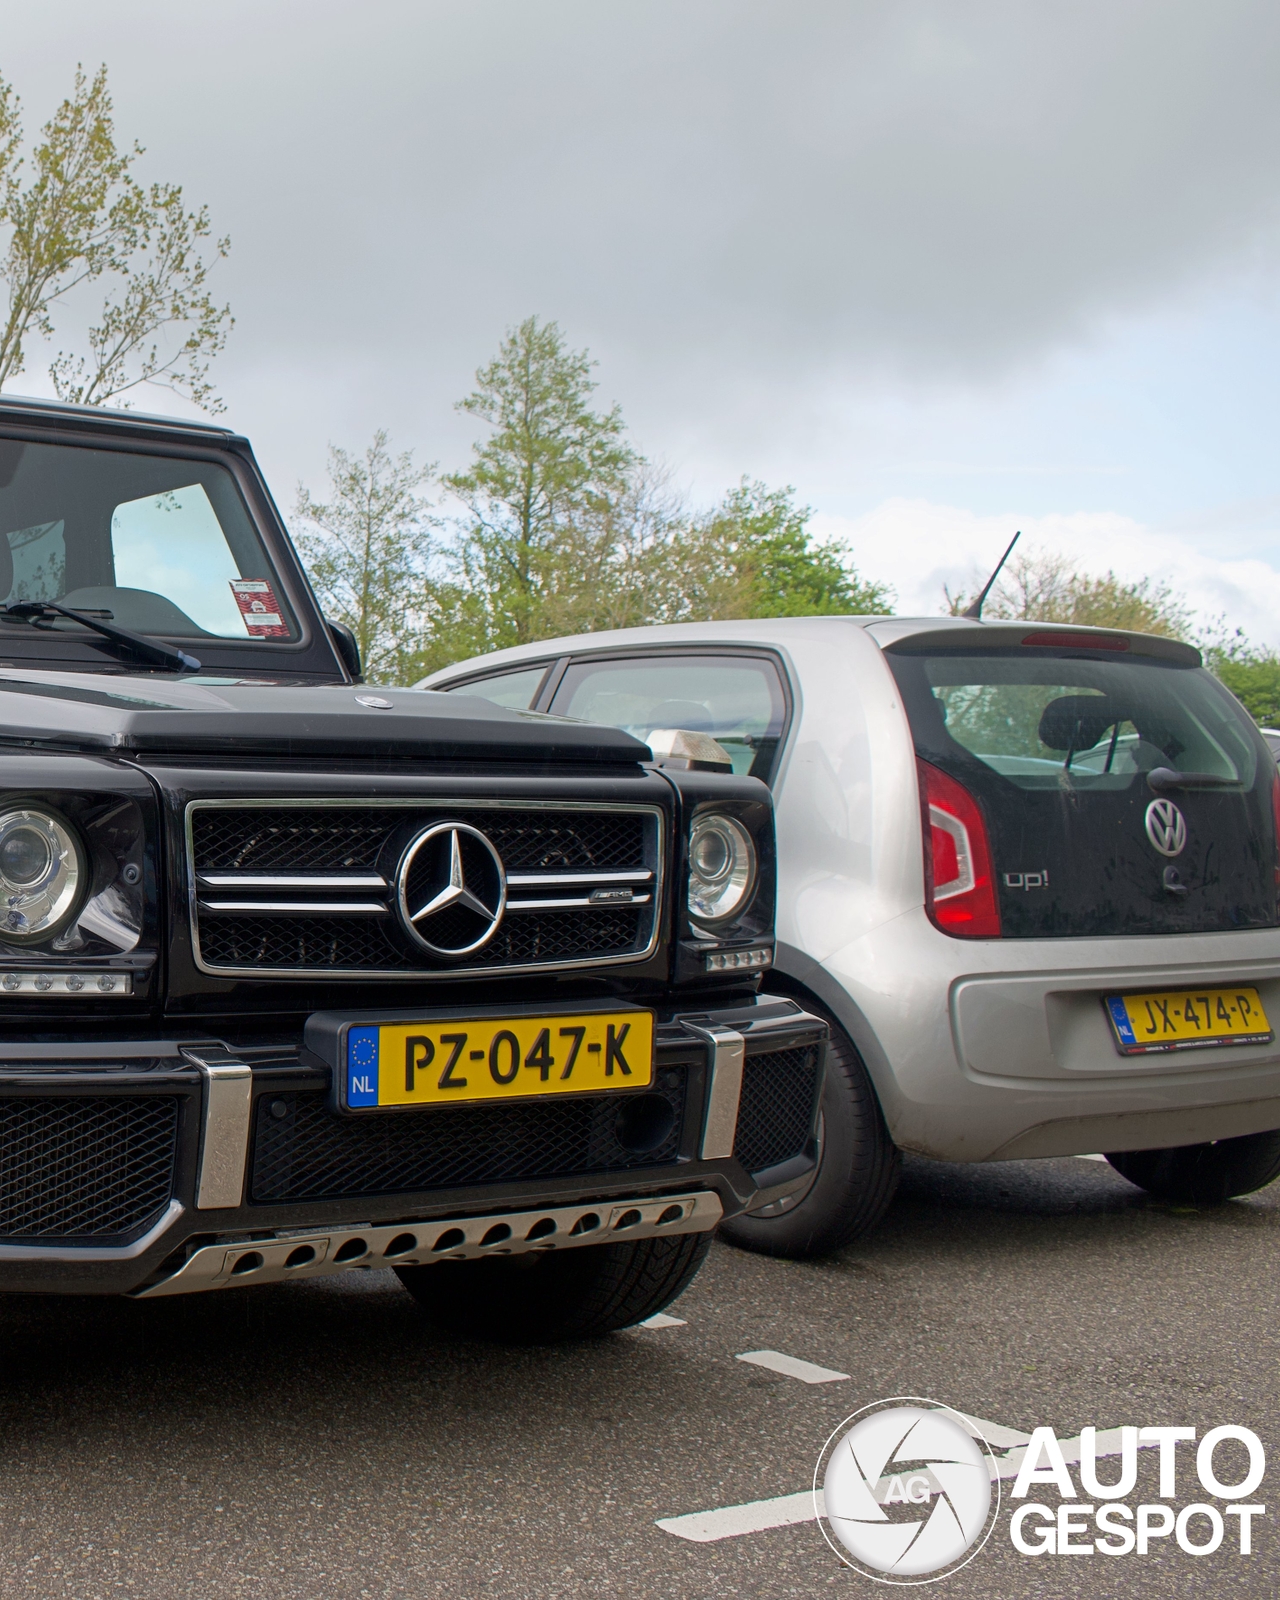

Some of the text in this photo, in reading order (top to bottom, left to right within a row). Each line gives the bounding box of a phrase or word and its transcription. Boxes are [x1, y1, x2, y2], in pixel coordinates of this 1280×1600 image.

[1004, 870, 1049, 891] up!
[1144, 994, 1252, 1035] JX-474-P
[1118, 1025, 1132, 1036] NL
[405, 1022, 632, 1091] PZ-047-K
[352, 1075, 374, 1094] NL
